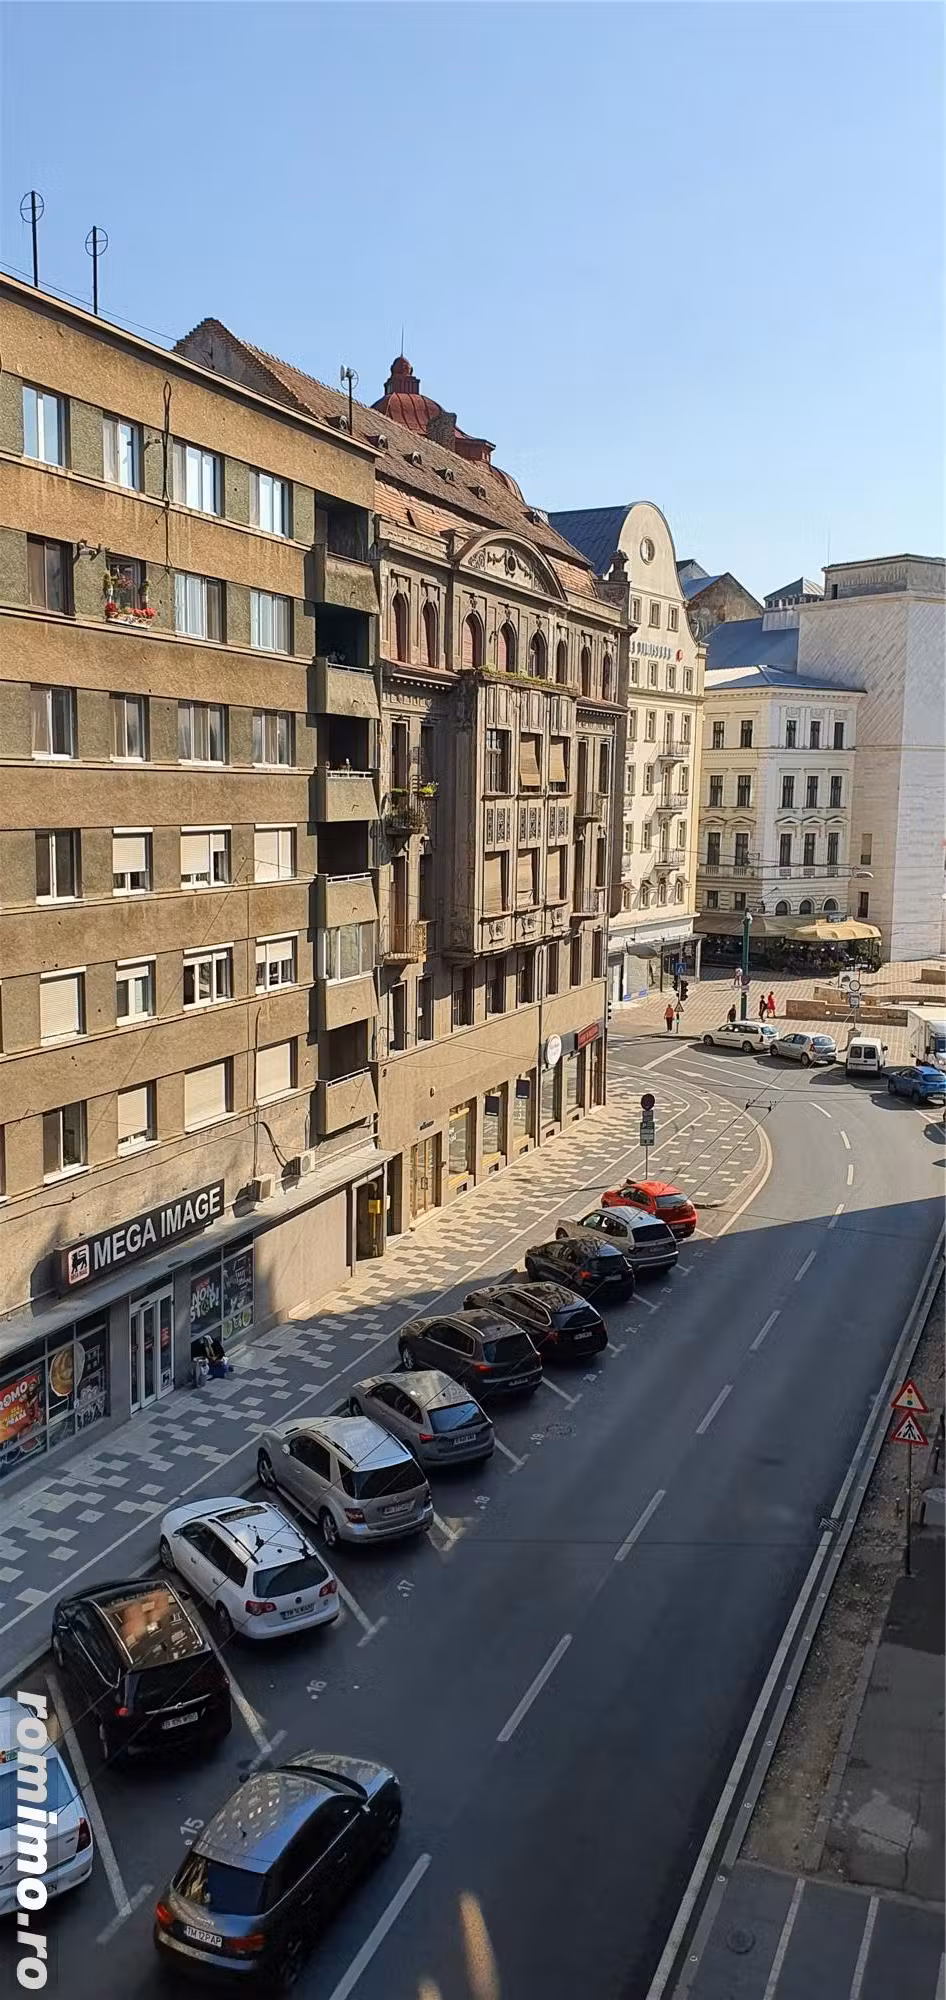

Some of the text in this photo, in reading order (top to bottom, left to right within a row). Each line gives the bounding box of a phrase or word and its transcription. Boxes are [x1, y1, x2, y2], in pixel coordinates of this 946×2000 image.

[94, 1187, 221, 1270] MEGA IMAGE
[397, 1579, 415, 1591] 17
[306, 1679, 327, 1693] 16
[180, 1817, 204, 1835] 15
